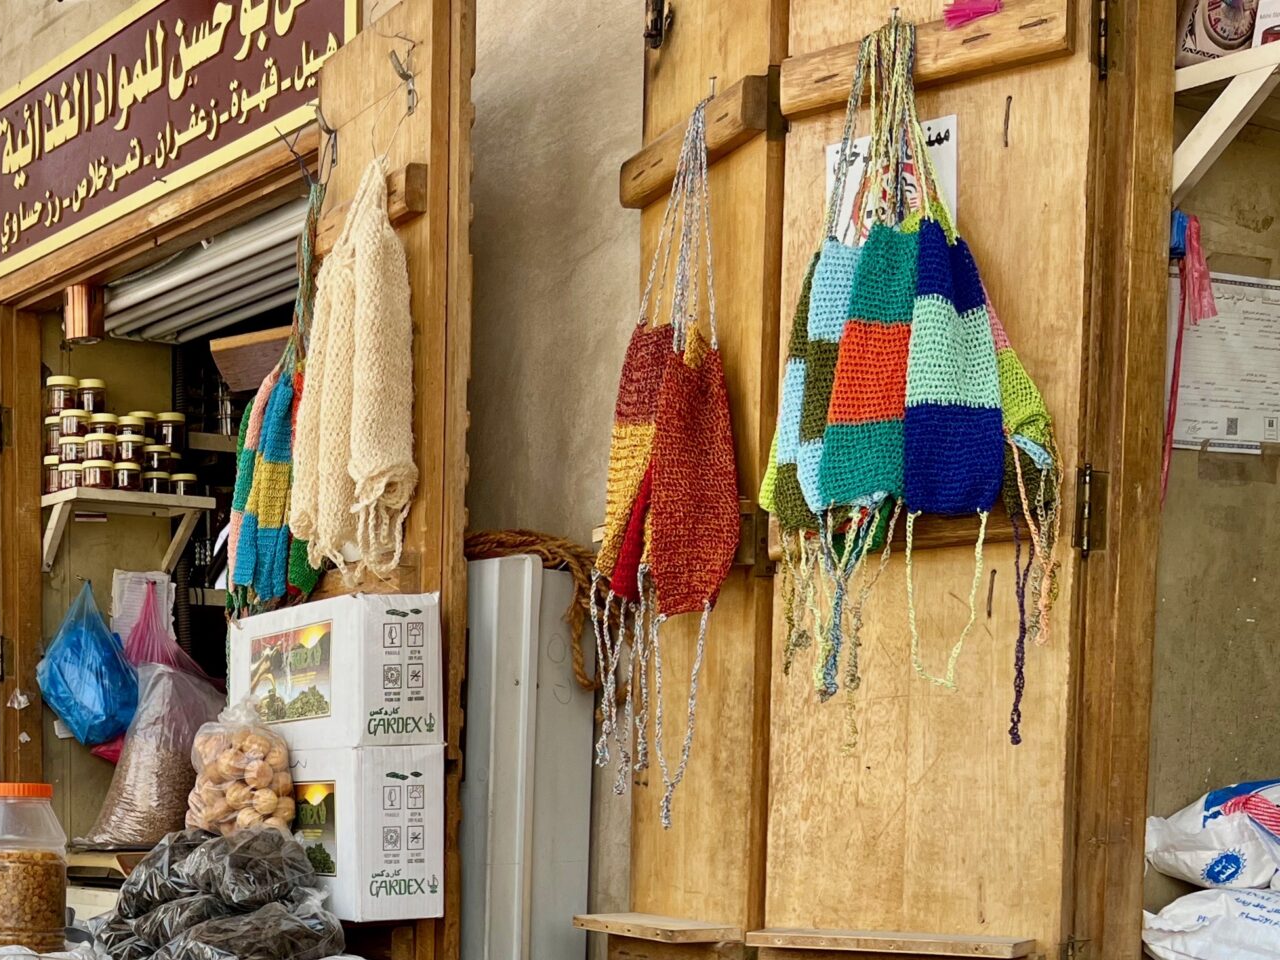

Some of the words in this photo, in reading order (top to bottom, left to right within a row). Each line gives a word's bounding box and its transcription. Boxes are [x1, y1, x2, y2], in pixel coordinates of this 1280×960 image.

[94, 18, 164, 131] للمواد
[168, 1, 233, 101] حسن
[294, 31, 338, 92] هيل
[228, 57, 278, 124] قهوة
[155, 98, 217, 169] زعفران
[72, 155, 108, 212] خلاص
[108, 137, 141, 192] تمر
[1, 201, 42, 254] حساوي
[44, 190, 60, 228] رز
[367, 716, 423, 736] GARDEX
[369, 878, 425, 898] GARDEX
